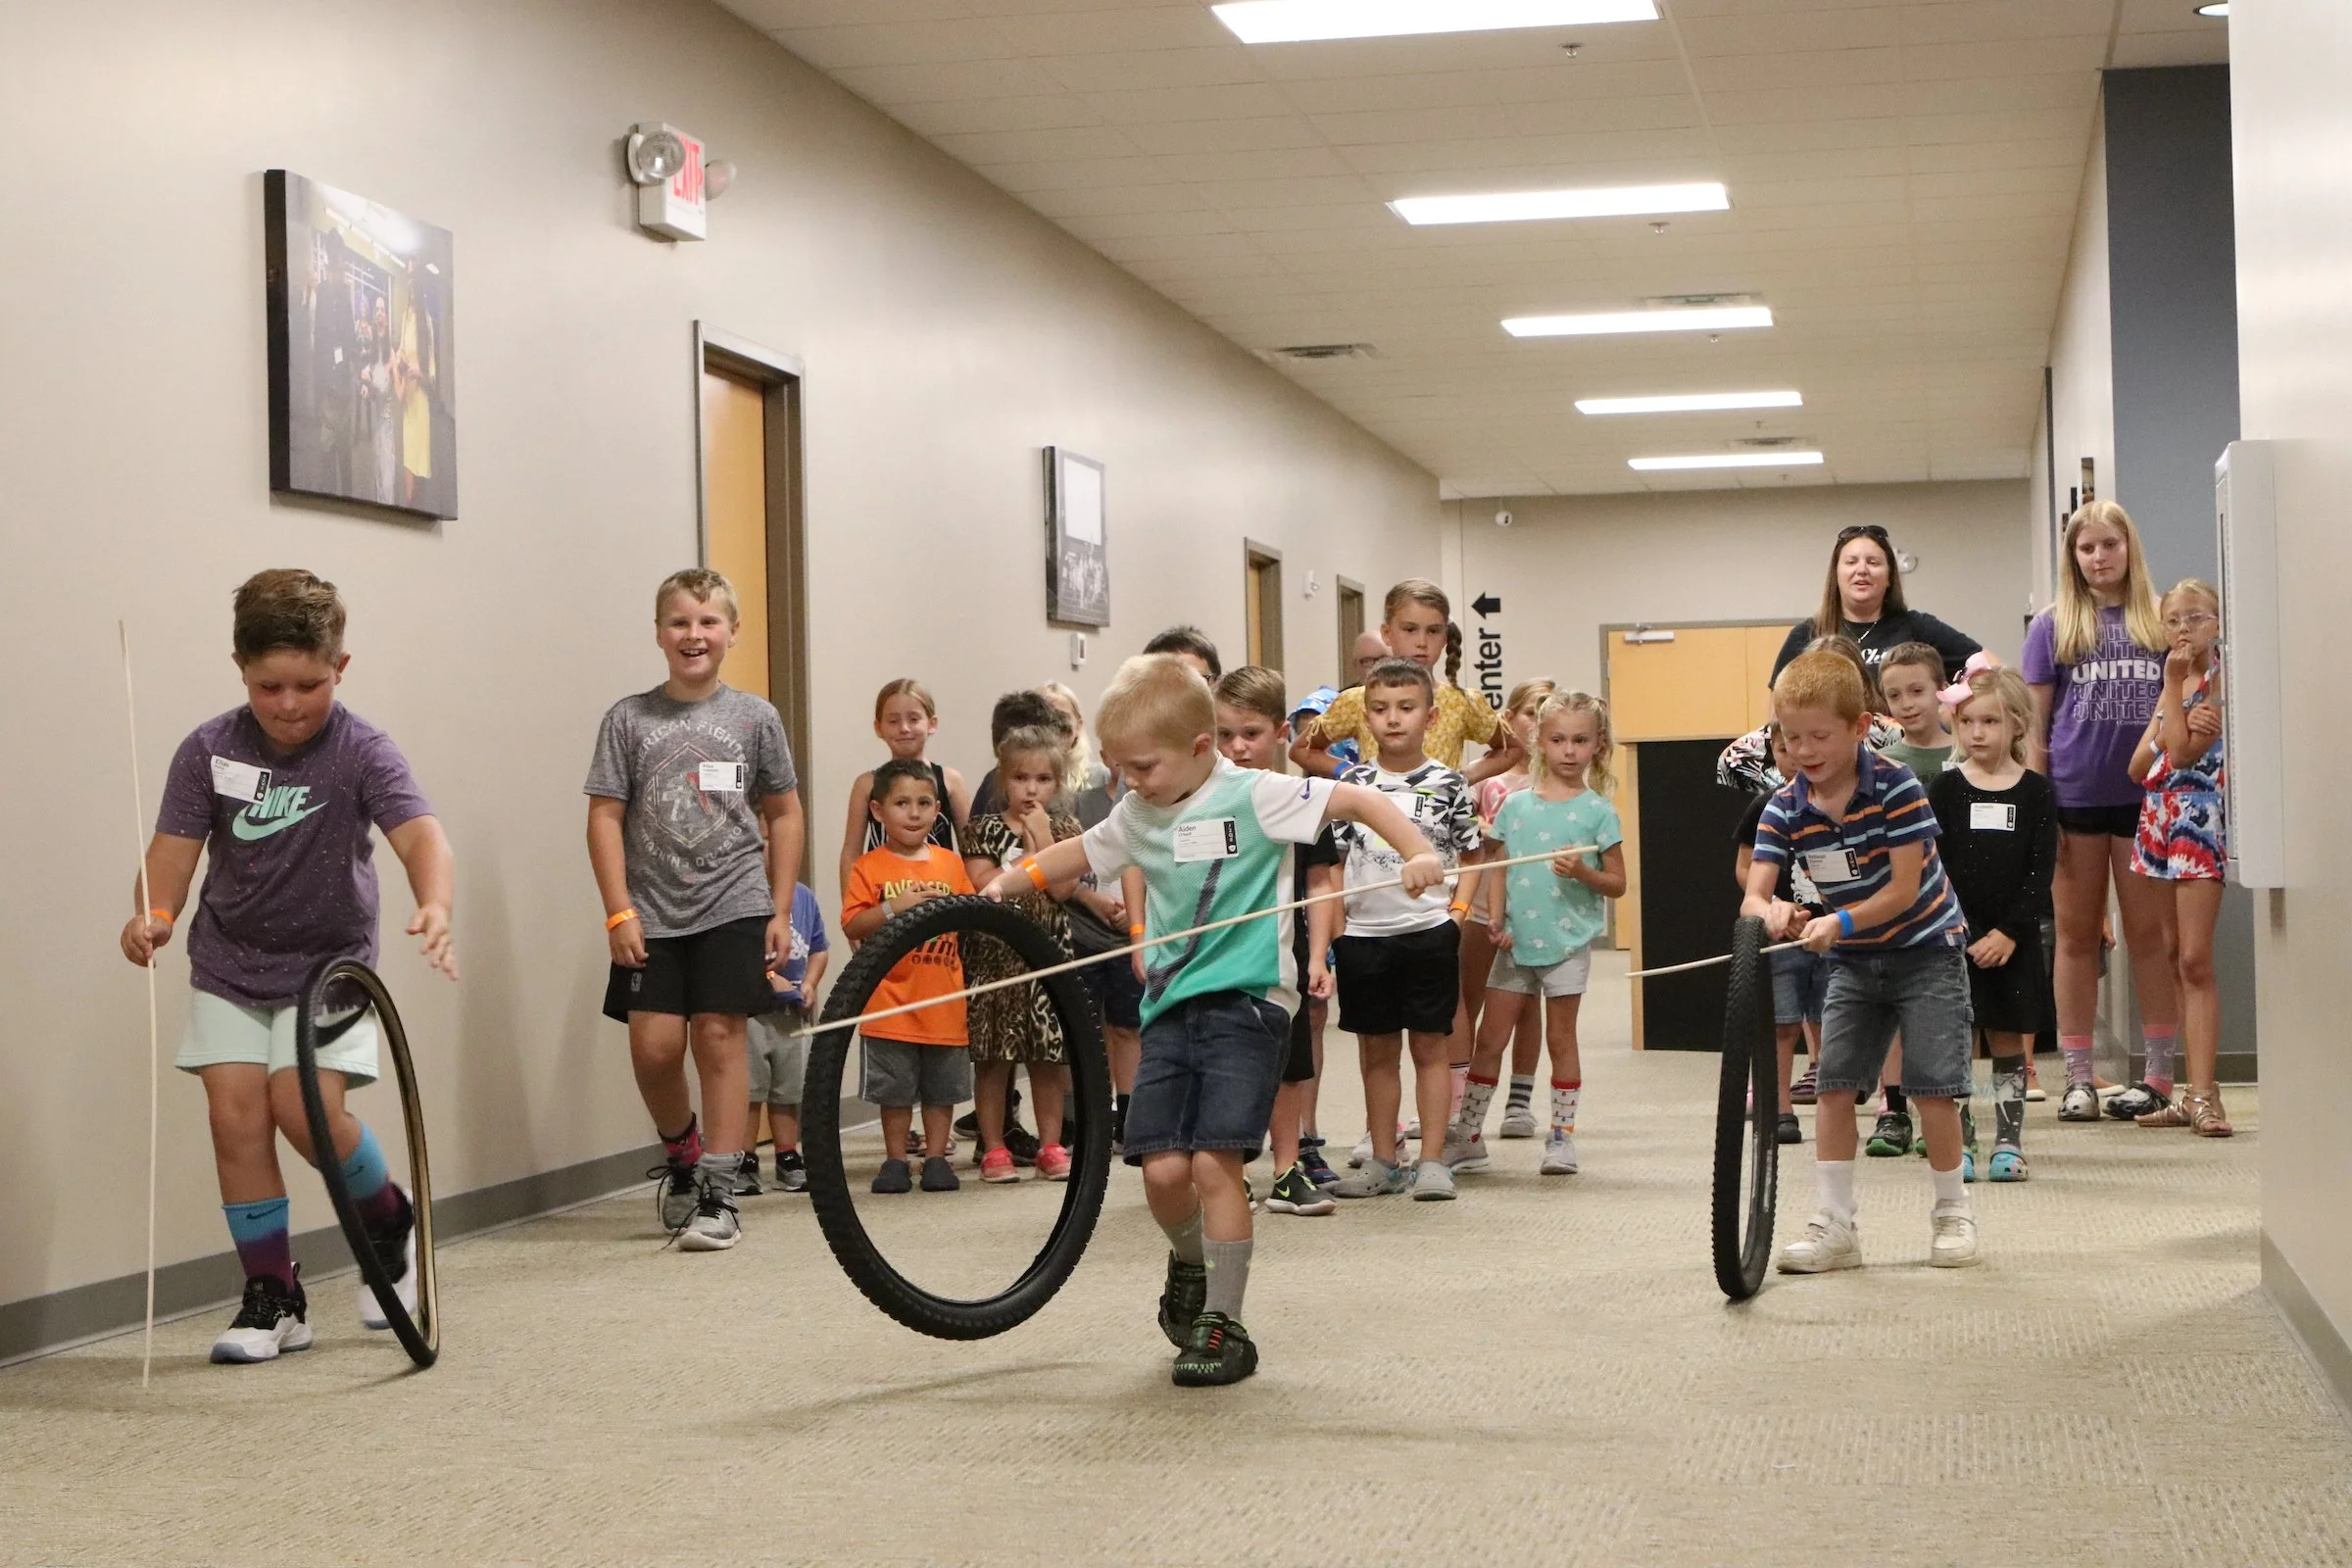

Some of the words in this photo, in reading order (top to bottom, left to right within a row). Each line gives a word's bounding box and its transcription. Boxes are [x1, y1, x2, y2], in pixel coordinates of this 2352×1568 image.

[2072, 659, 2161, 685] UNITED
[2073, 699, 2158, 722] UNITE
[247, 785, 312, 818] NIKE
